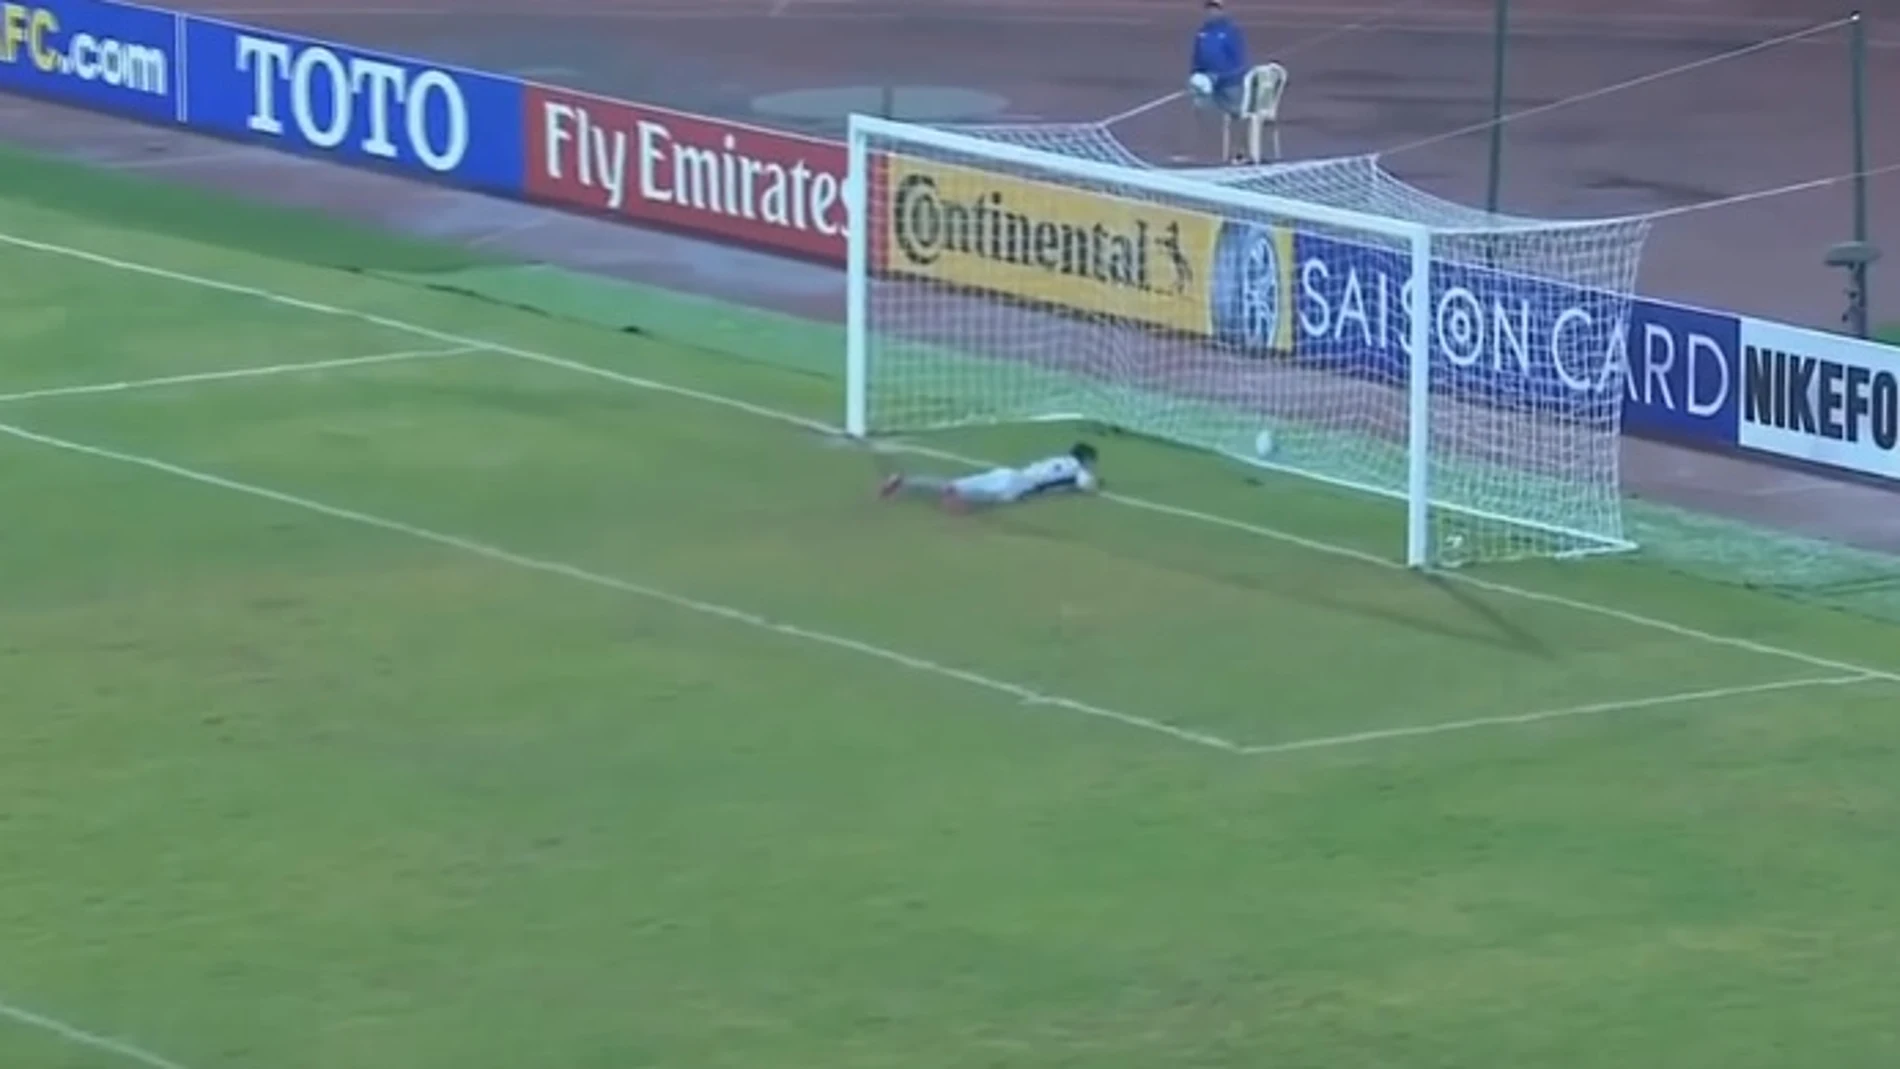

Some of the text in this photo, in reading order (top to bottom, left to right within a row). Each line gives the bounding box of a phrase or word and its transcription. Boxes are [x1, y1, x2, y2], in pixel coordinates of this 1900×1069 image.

[0, 3, 168, 95] FC.com
[235, 35, 469, 171] TOTO
[544, 101, 627, 209] Fly
[895, 174, 1150, 292] Continental
[1551, 306, 1730, 417] CARD
[1745, 344, 1898, 450] NIKEFO
